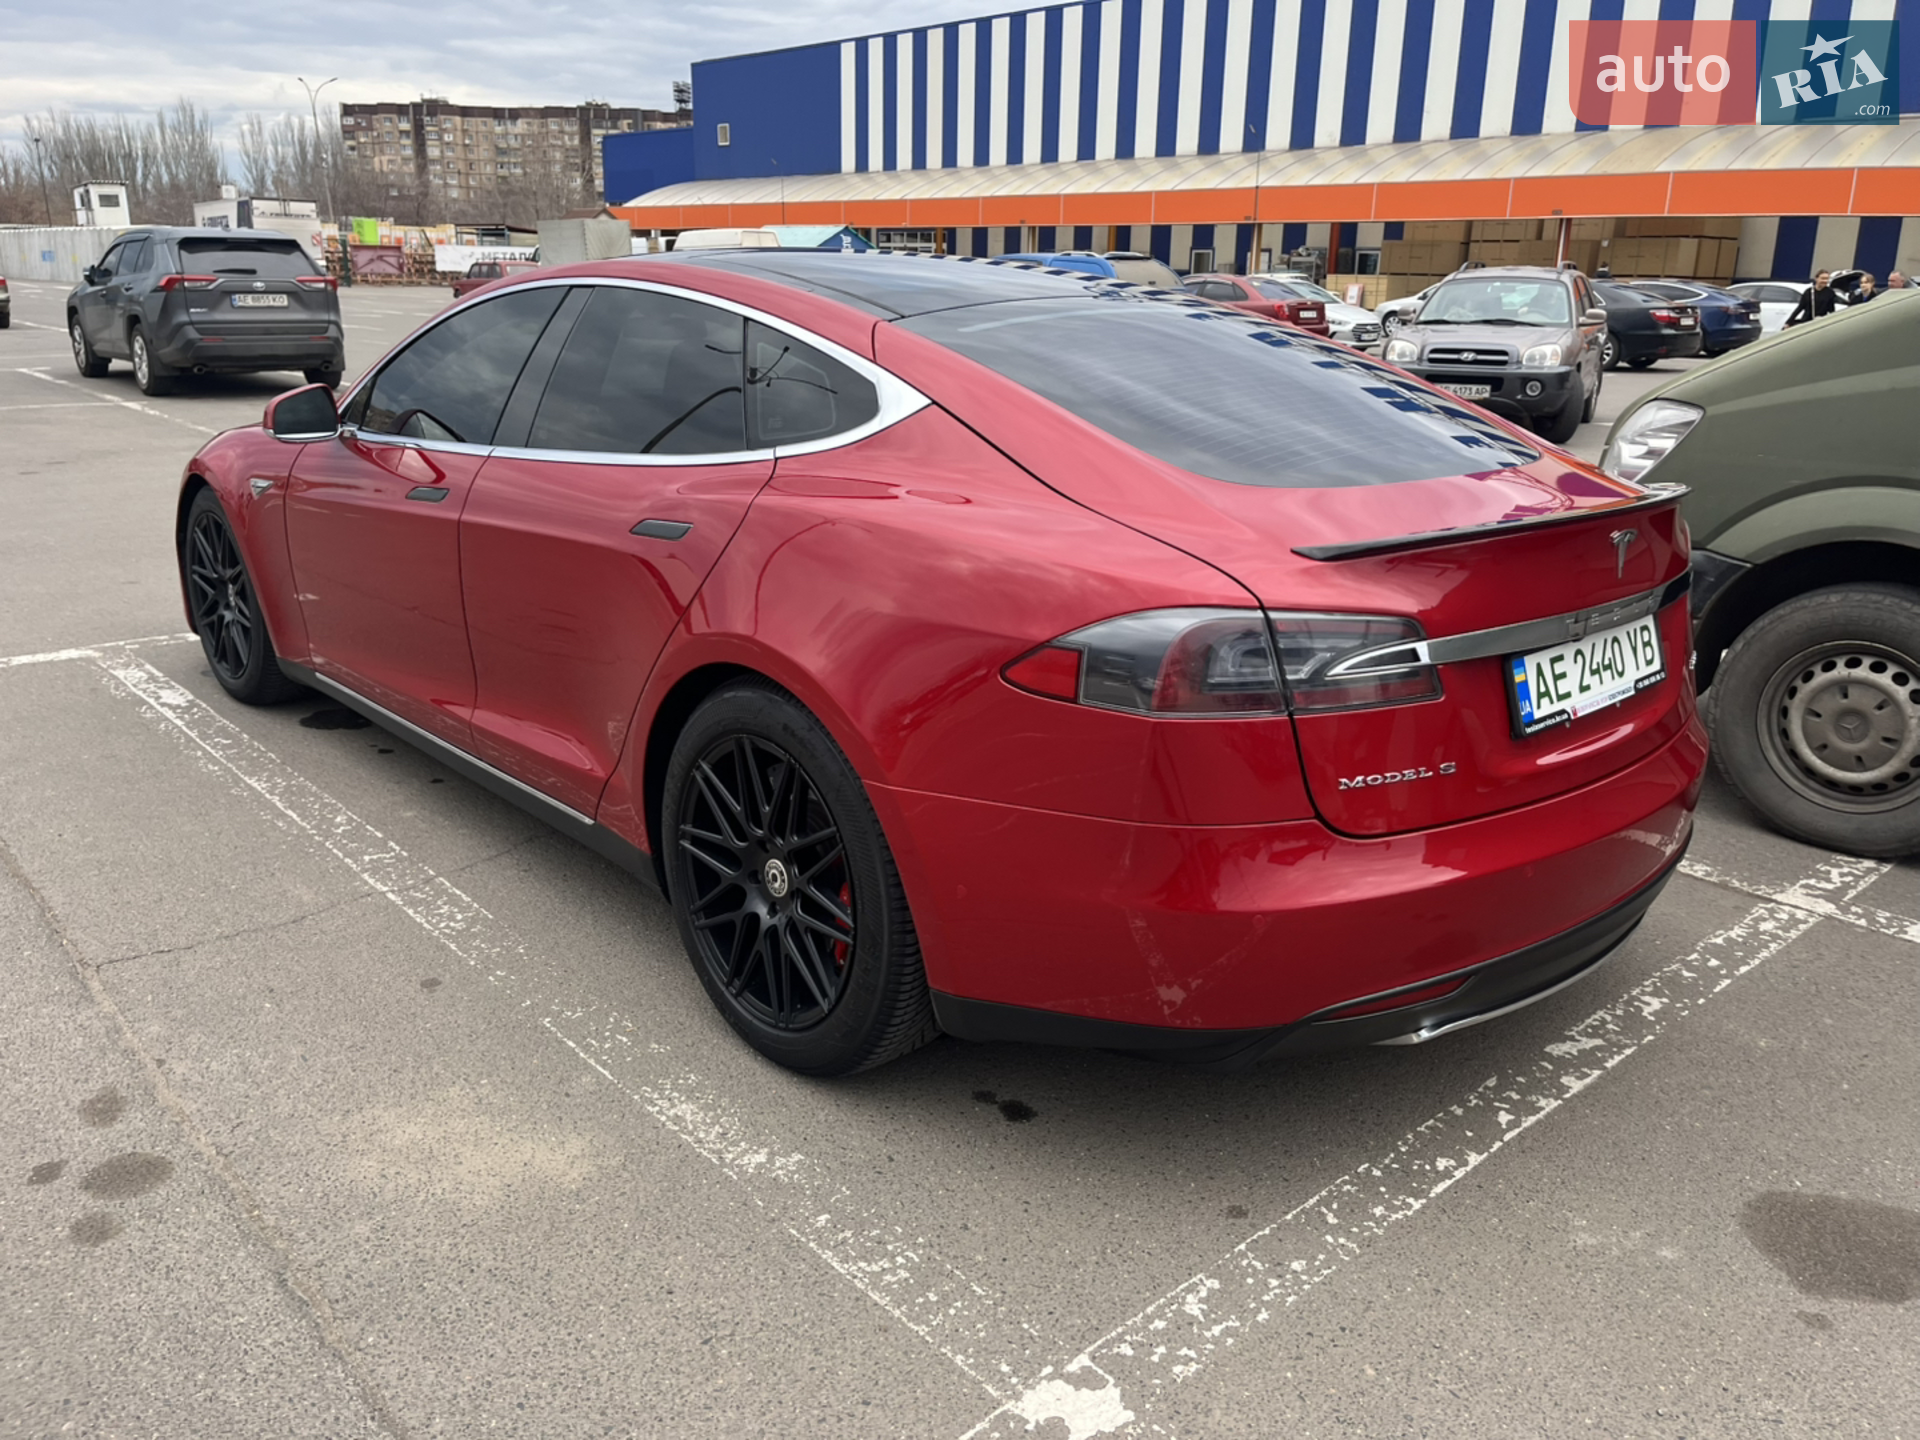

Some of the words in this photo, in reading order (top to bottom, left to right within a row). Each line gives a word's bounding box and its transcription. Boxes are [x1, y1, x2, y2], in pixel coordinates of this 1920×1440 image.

[1536, 653, 1572, 710] AE
[1573, 635, 1625, 694] 2440
[1626, 624, 1655, 671] YB
[1519, 699, 1532, 715] UA
[1338, 767, 1433, 790] MODEL
[1439, 762, 1456, 774] S
